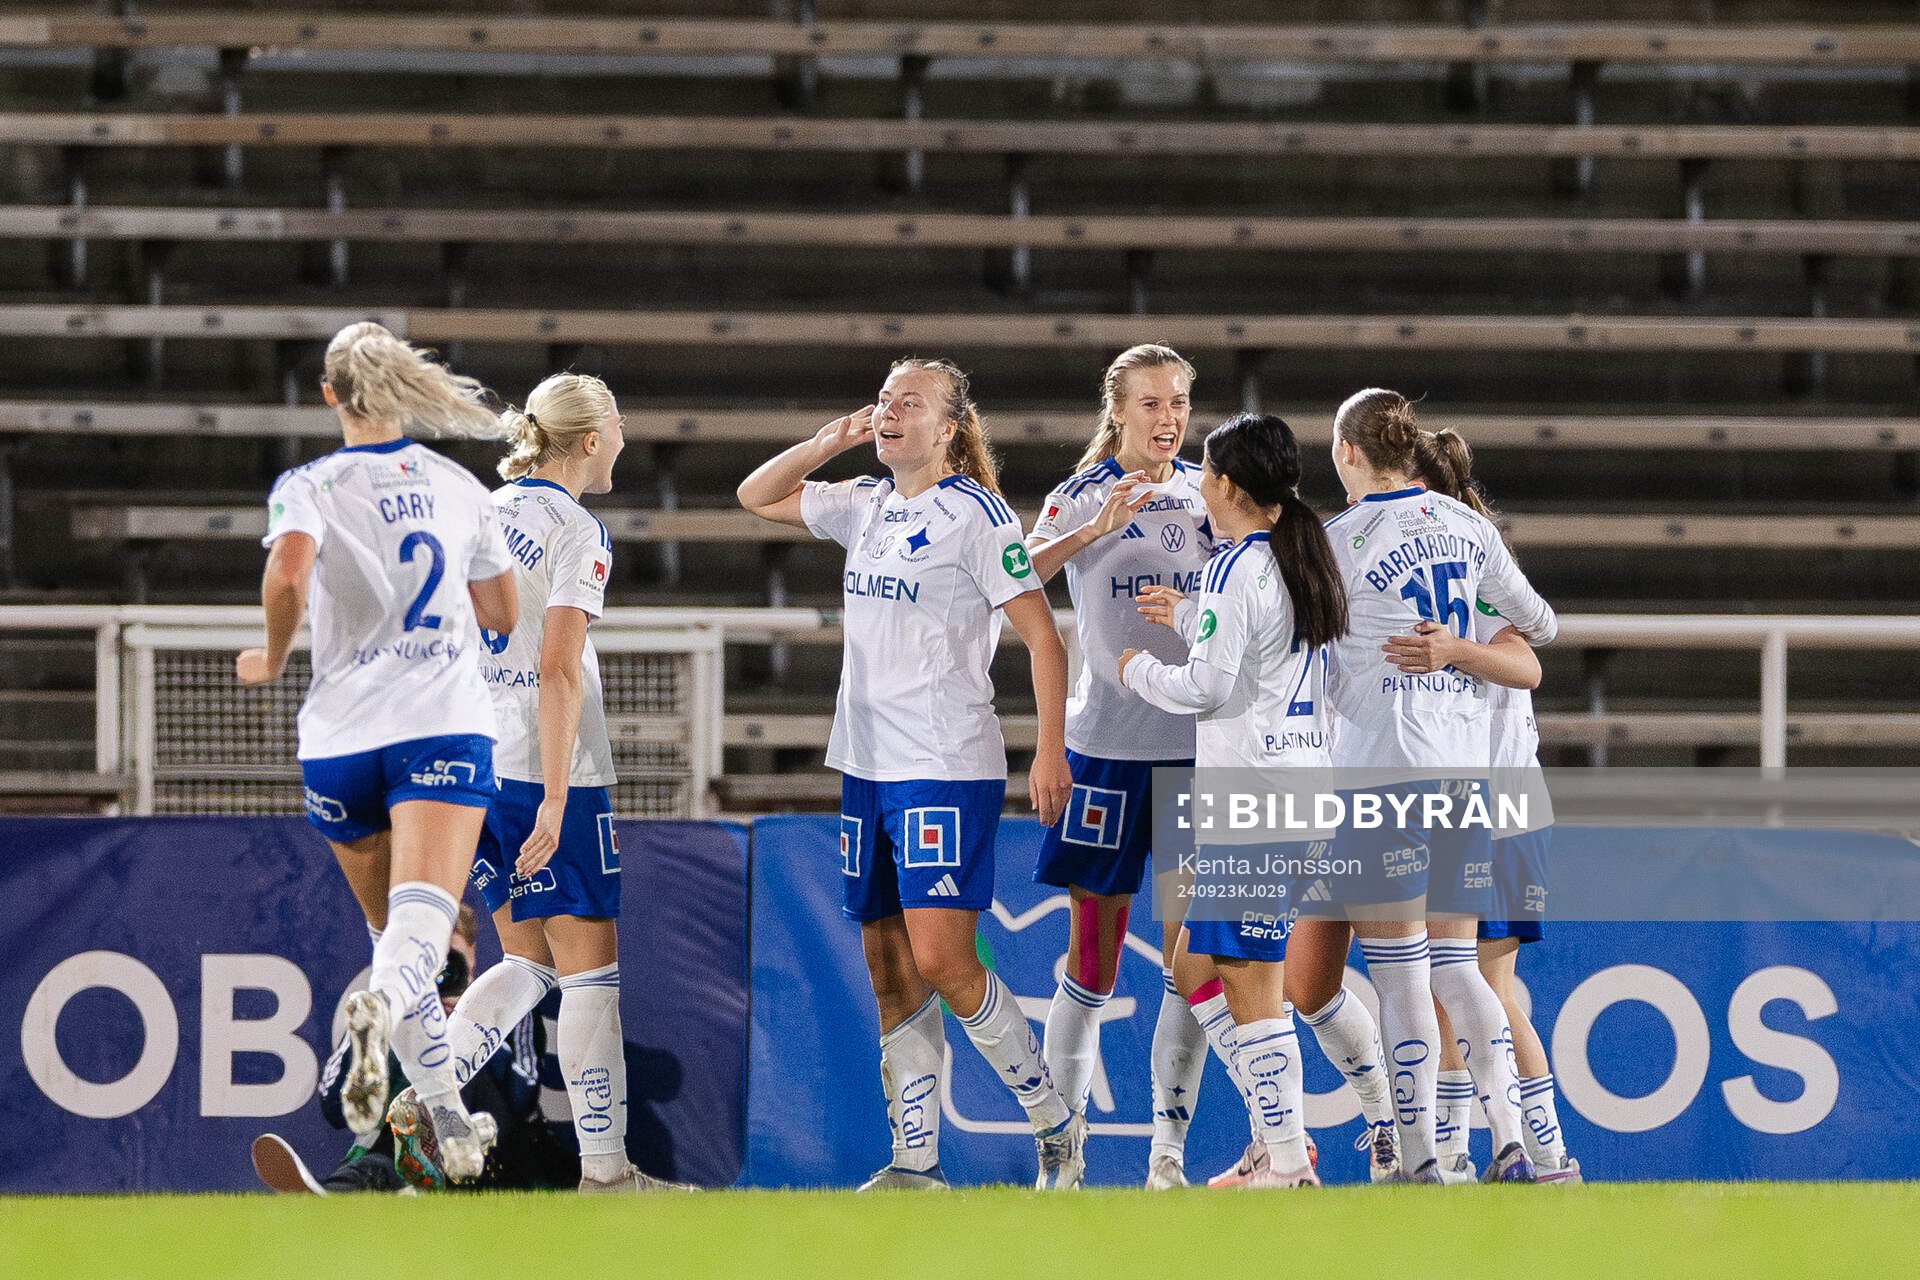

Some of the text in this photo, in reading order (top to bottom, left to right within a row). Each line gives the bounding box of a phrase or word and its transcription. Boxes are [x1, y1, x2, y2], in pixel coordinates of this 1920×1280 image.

[380, 493, 435, 523] CARY
[400, 531, 446, 632] 2
[845, 570, 920, 603] OLMEN
[1400, 561, 1469, 674] 15
[1265, 731, 1328, 751] PLATINU
[1240, 924, 1282, 940] zero
[570, 1066, 613, 1133] Ocab
[901, 1073, 937, 1149] Ocab
[1248, 1051, 1293, 1127] Ocab
[1391, 1038, 1429, 1126] Ocab
[1524, 1104, 1558, 1146] cab
